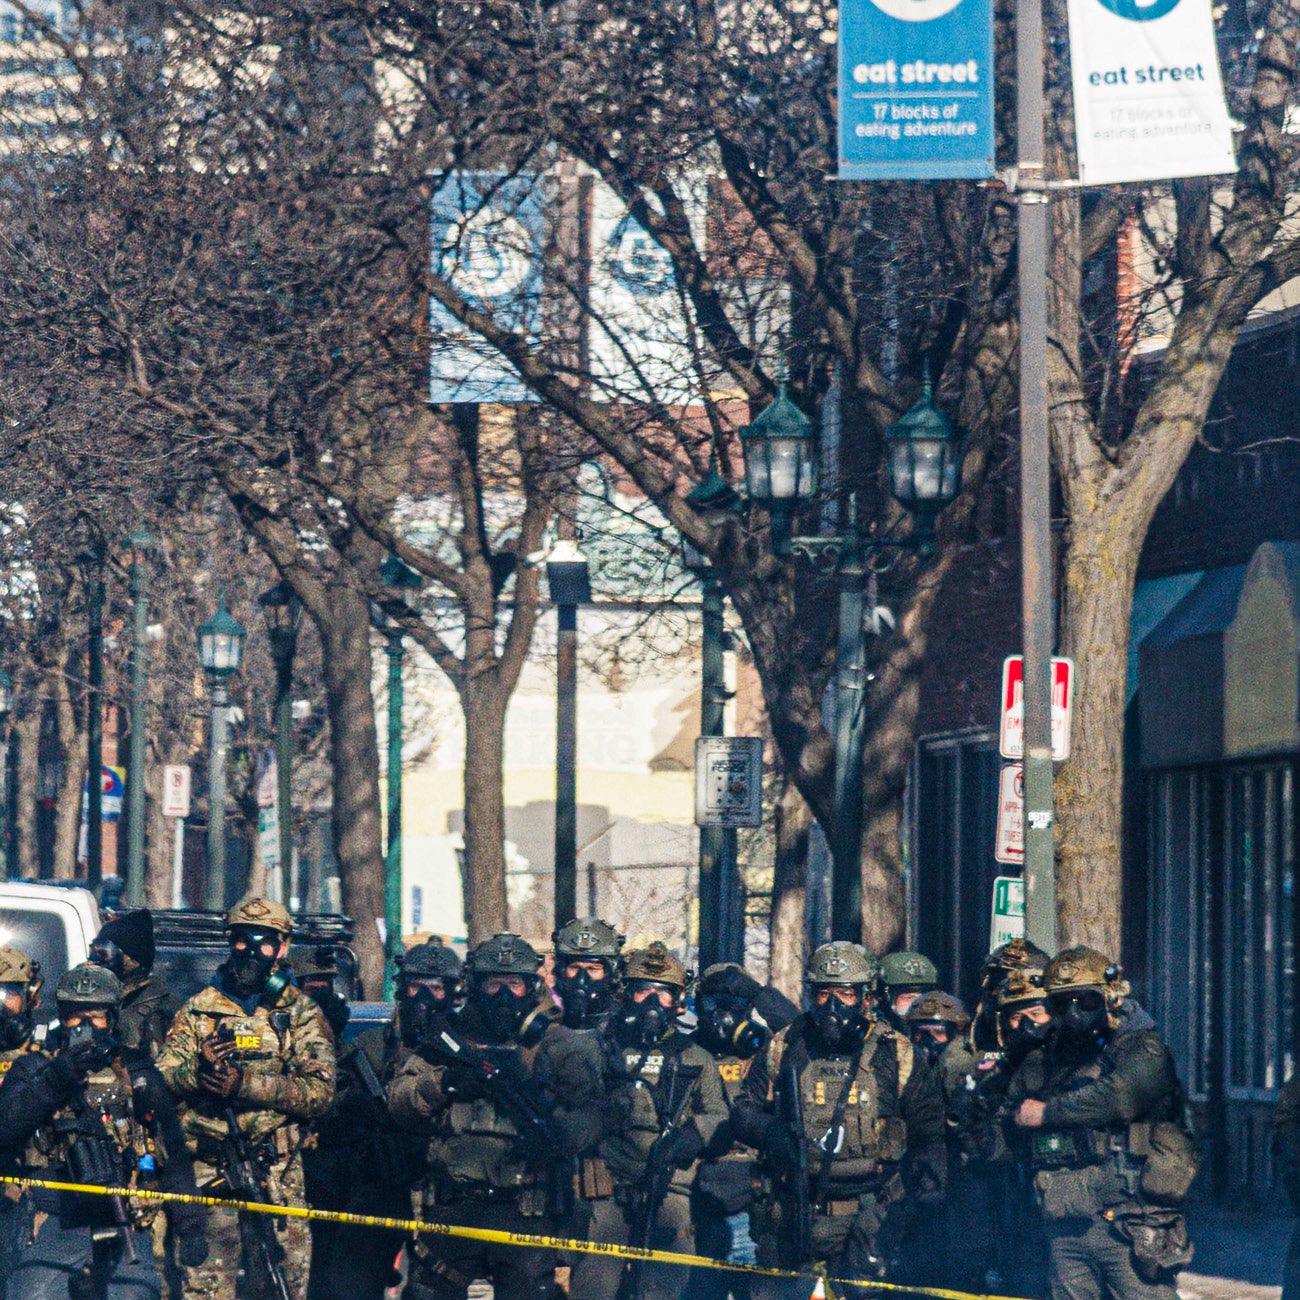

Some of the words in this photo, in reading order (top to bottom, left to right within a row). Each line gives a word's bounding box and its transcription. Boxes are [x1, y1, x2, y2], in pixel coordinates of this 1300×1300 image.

[853, 59, 897, 83] eat
[901, 59, 979, 83] street
[1088, 66, 1128, 86] eat
[1135, 63, 1206, 84] street
[873, 102, 888, 119] 17
[891, 104, 940, 120] blocks
[943, 103, 958, 119] of
[855, 123, 900, 140] eating
[903, 121, 977, 137] adventure
